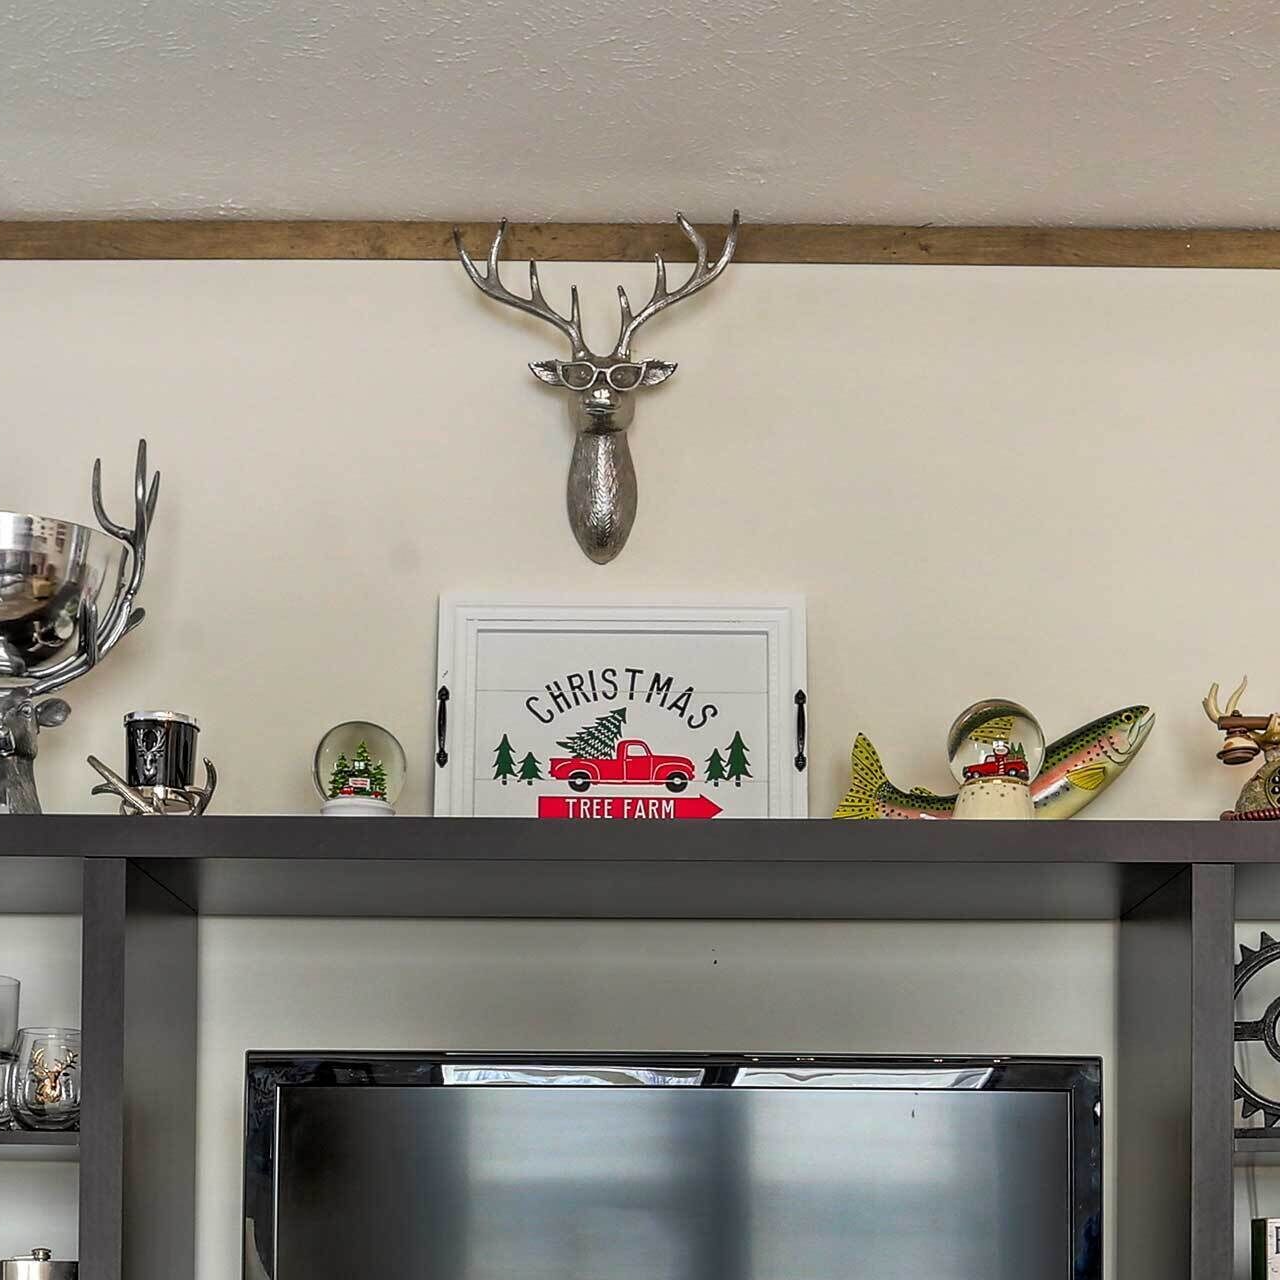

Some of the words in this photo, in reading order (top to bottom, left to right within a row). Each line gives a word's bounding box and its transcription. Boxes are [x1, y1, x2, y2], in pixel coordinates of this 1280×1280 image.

[525, 667, 719, 730] CHRISTMAS
[565, 799, 613, 819] TREE
[623, 799, 675, 819] FARM
